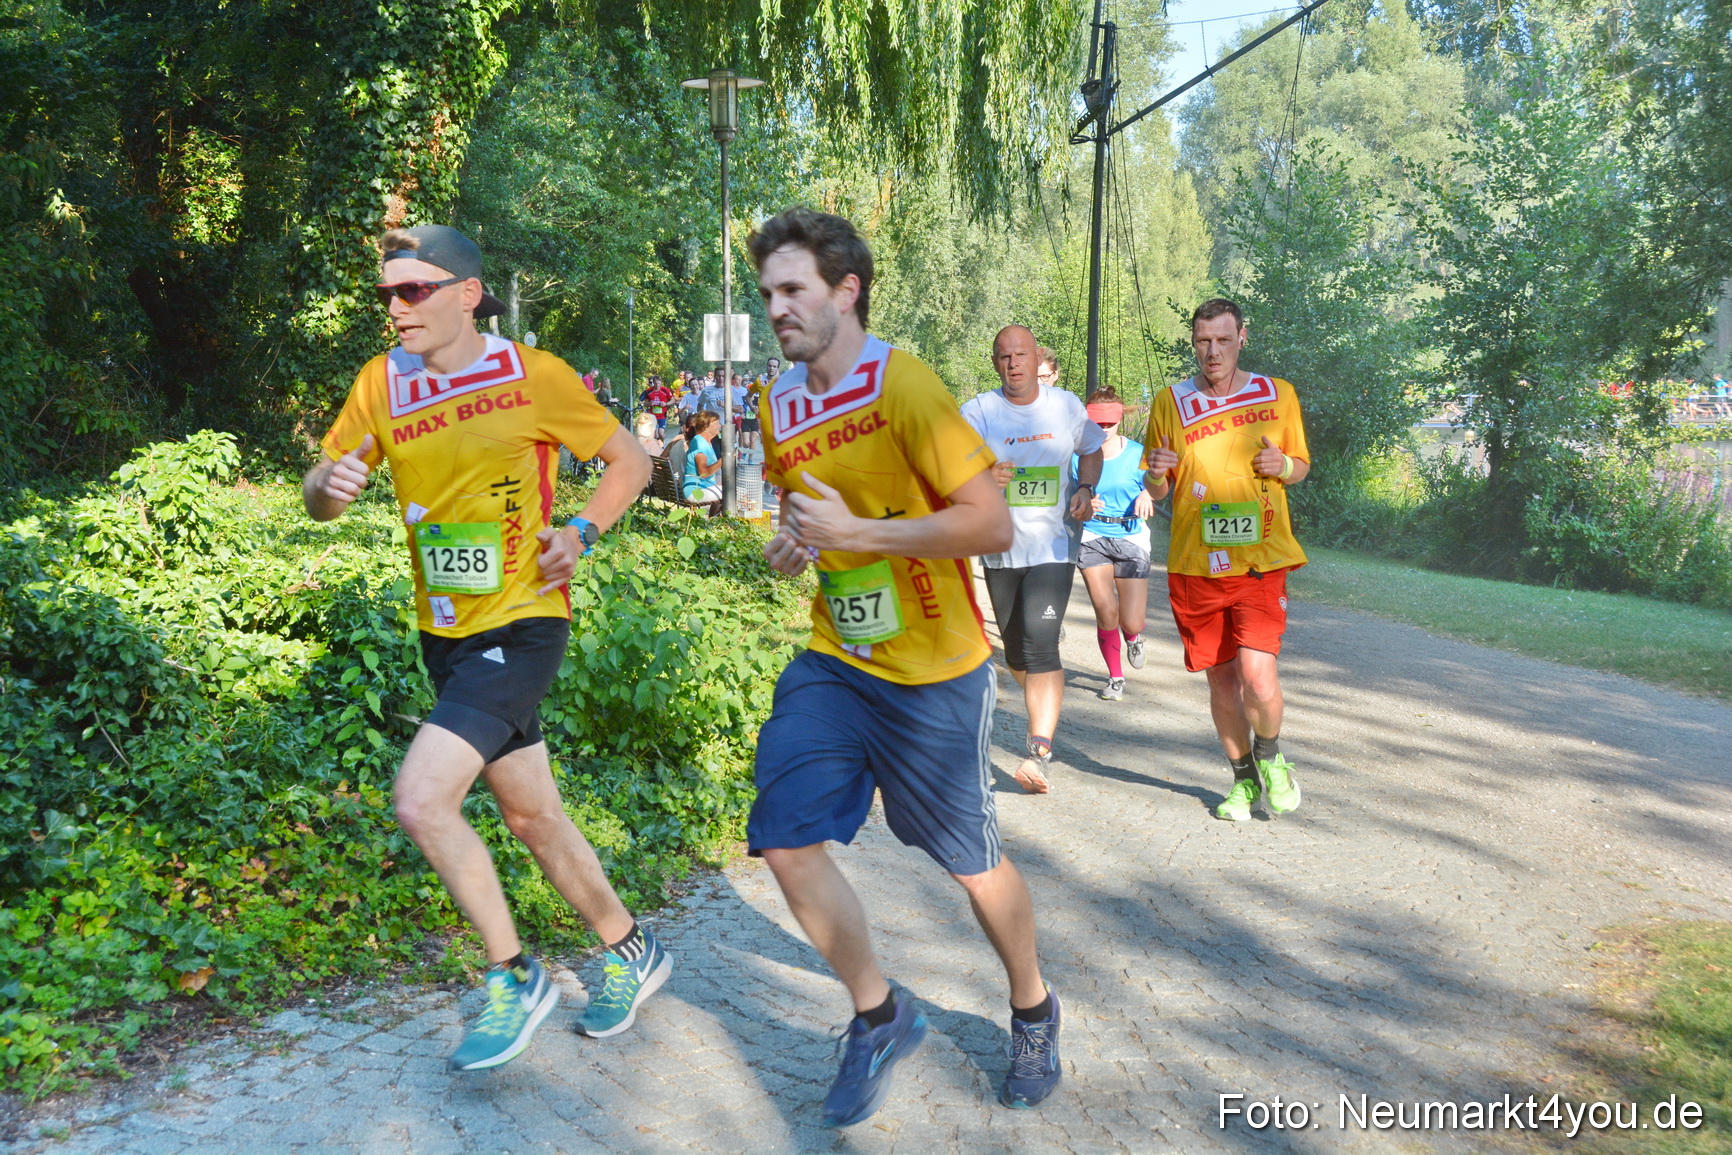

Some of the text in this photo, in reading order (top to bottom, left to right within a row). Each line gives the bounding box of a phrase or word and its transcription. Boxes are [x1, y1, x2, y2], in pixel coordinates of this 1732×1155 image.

[392, 390, 532, 445] MAX BÖGL
[1184, 408, 1279, 446] MAX BÖGL
[777, 438, 823, 473] MAX
[827, 411, 889, 451] BÖGL
[1018, 481, 1047, 496] 871
[1208, 517, 1253, 534] 1212
[427, 547, 488, 573] 1258
